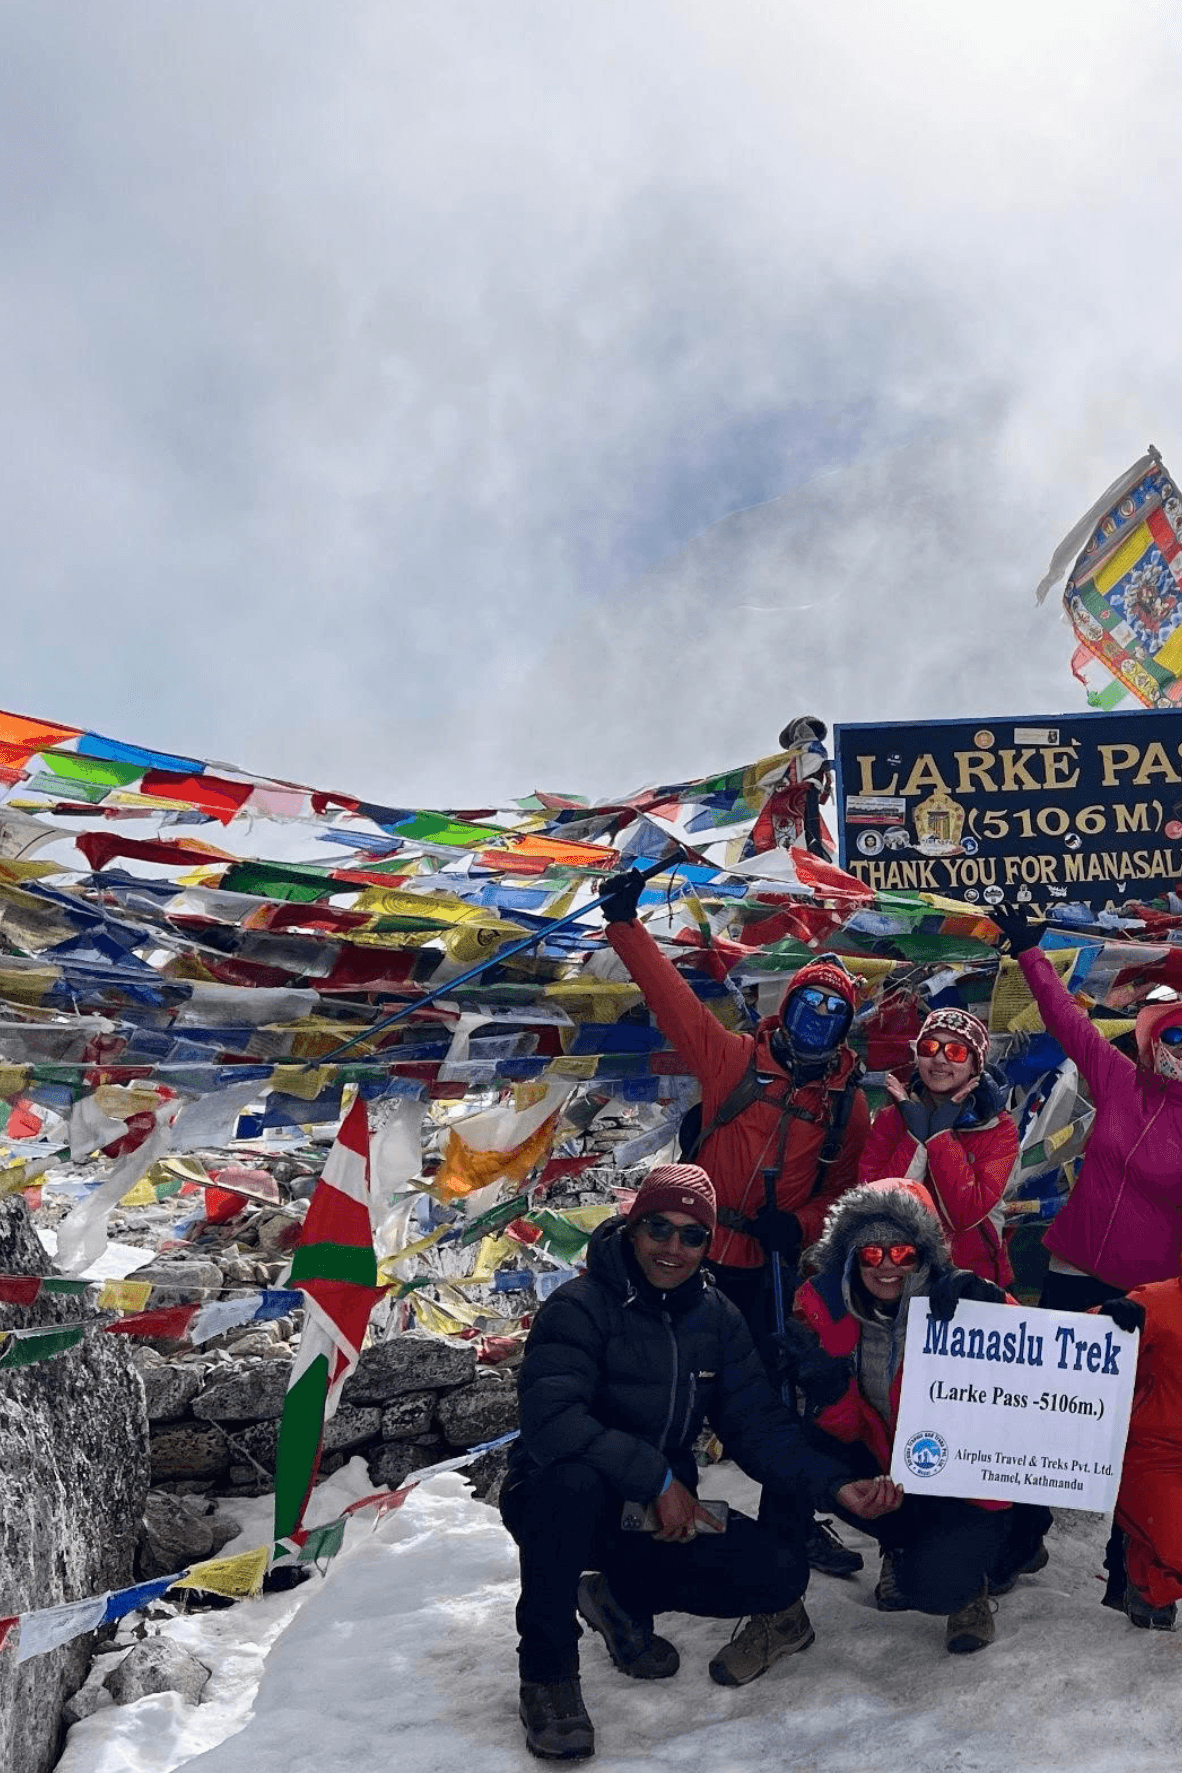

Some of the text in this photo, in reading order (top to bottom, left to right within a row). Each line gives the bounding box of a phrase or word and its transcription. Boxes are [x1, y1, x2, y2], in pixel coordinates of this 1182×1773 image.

[857, 746, 1080, 796] LARKE
[849, 858, 940, 890] THANK
[940, 857, 997, 888] YOU
[1003, 855, 1059, 885] FOR
[922, 1313, 1121, 1375] Manaslu Trek
[929, 1380, 987, 1403] (Larke
[992, 1387, 1028, 1408] Pass
[954, 1449, 1113, 1476] Airplus Travel & Treks Pvt. Ltd.
[981, 1469, 1084, 1491] Thamel, Kathmandu
